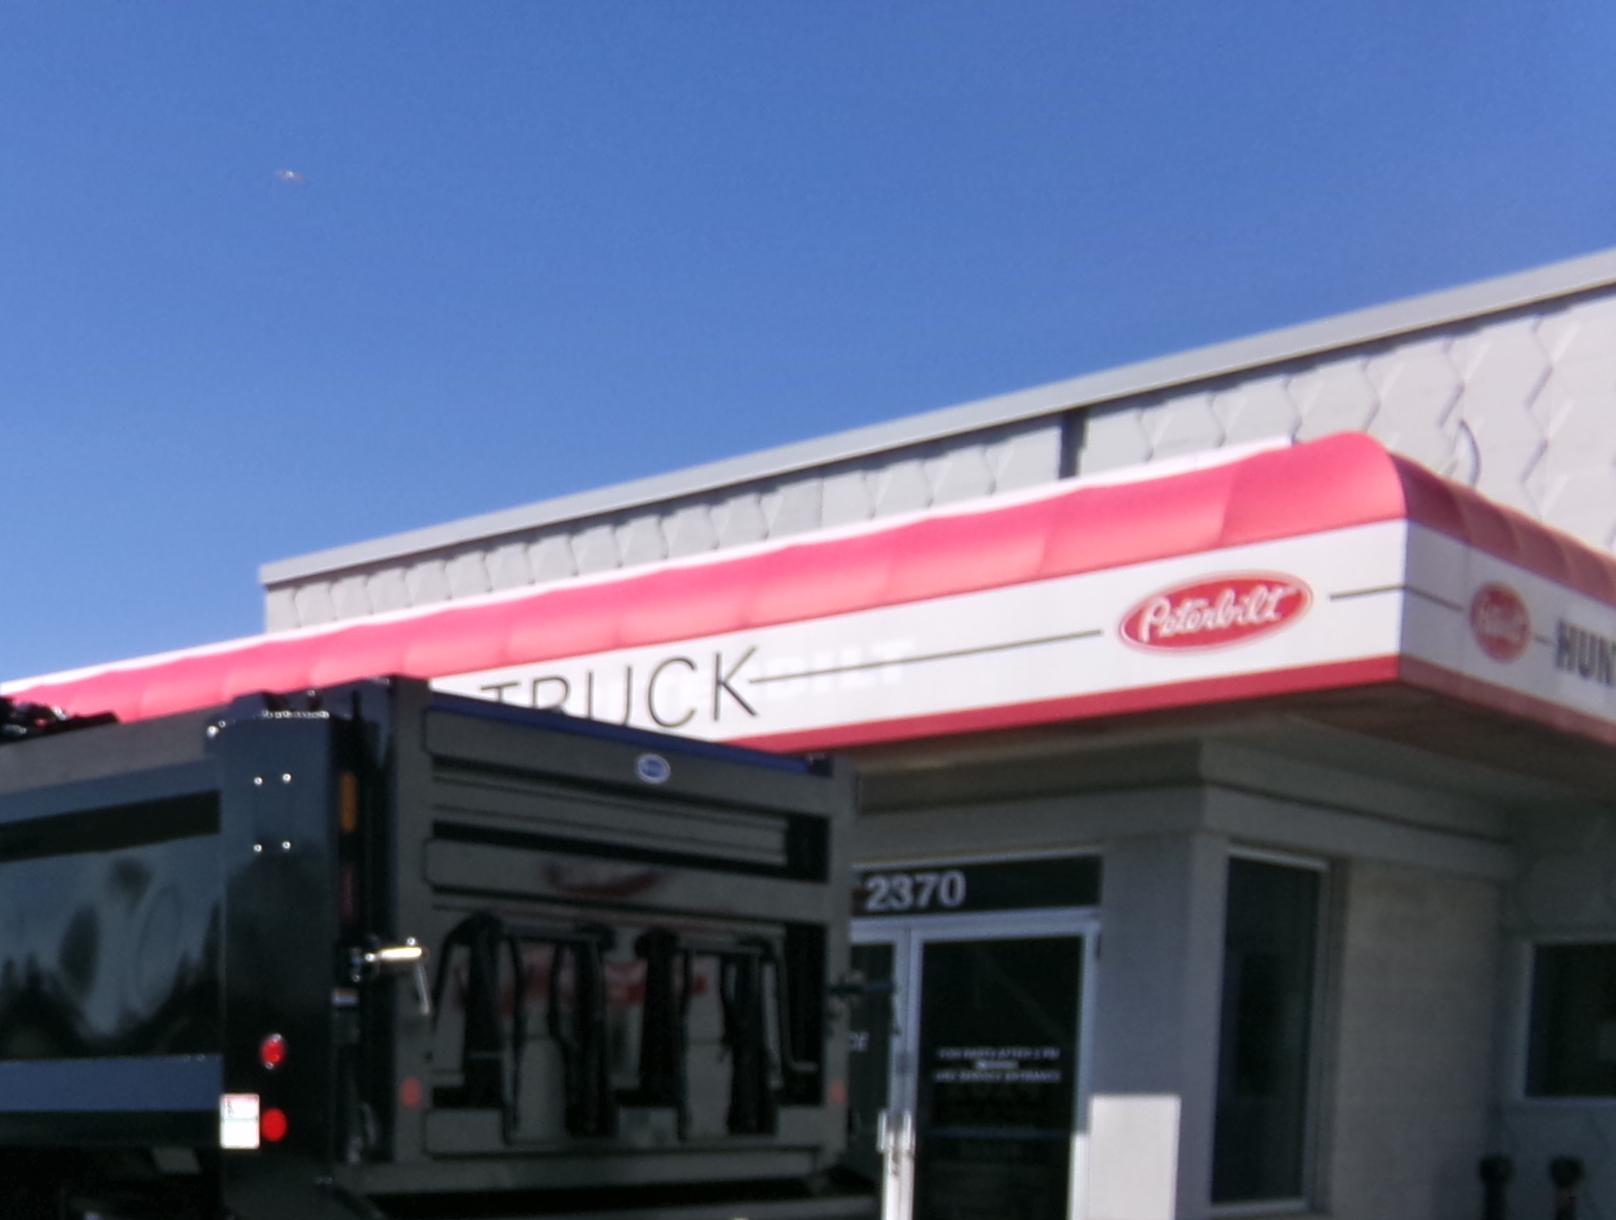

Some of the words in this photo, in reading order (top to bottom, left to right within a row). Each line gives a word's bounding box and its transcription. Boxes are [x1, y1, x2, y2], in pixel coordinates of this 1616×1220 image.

[1138, 584, 1299, 643] Peterbilt
[1556, 617, 1616, 687] HUN
[866, 869, 966, 912] 2370
